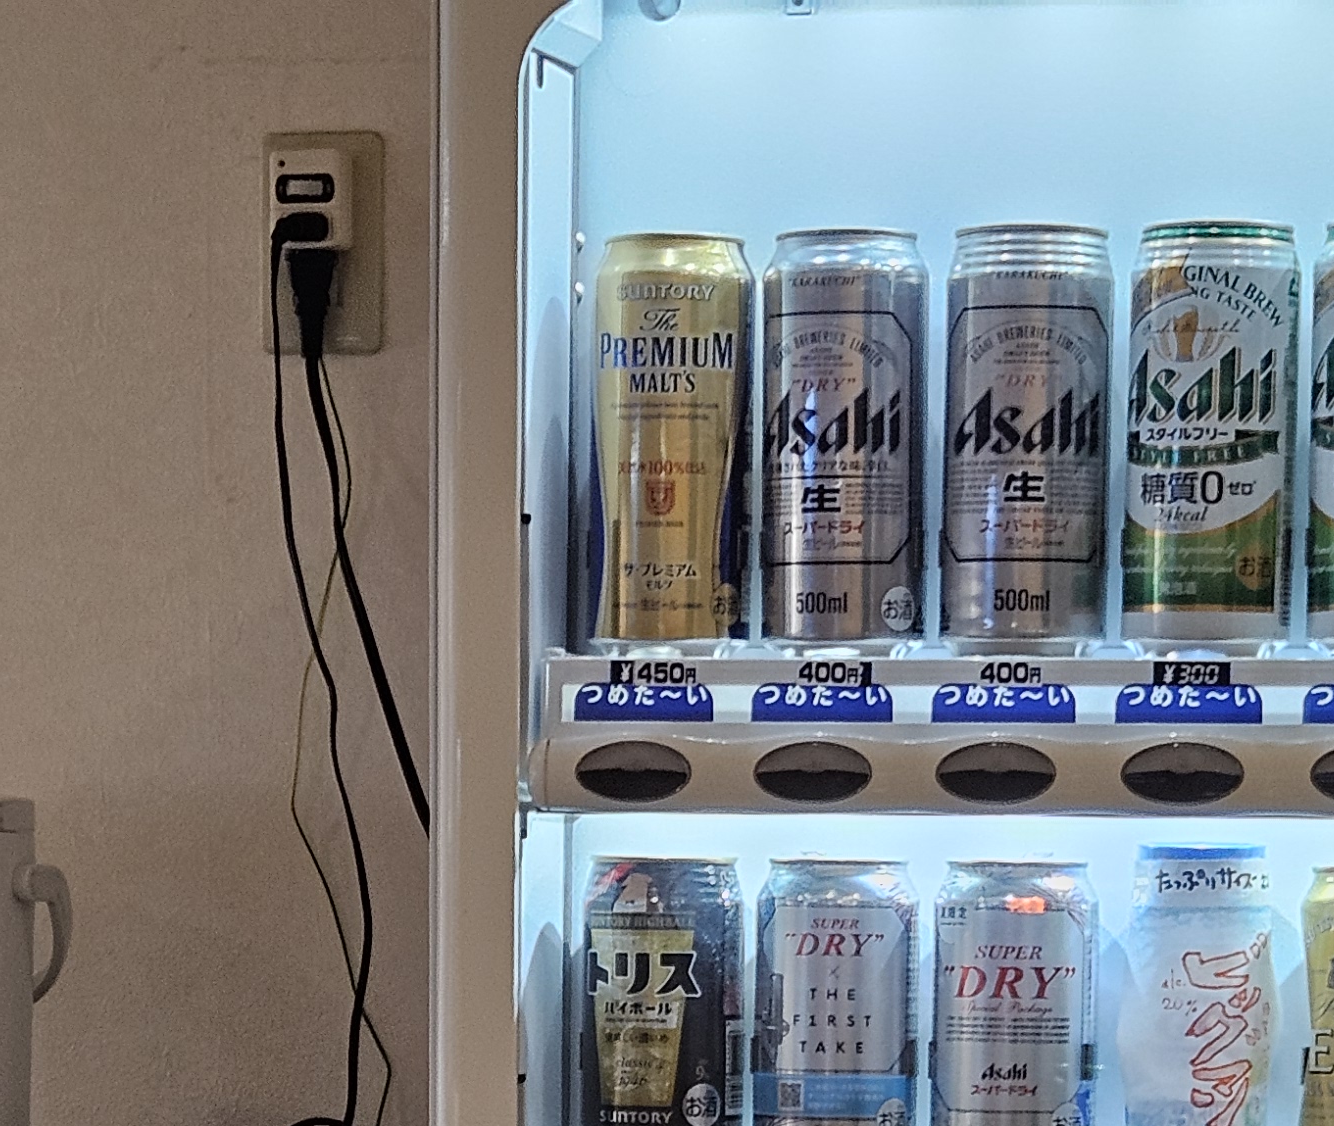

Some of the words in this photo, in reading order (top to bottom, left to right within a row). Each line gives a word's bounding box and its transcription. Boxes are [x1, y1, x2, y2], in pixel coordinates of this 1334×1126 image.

[617, 284, 714, 300] SUNTORY
[1217, 290, 1257, 320] TASTE
[1243, 282, 1284, 328] BREW
[639, 308, 680, 331] The
[600, 332, 734, 369] PREMIUM
[629, 370, 695, 393] MALT'S
[1128, 346, 1277, 425] Asahi
[766, 388, 900, 457] Asahi
[954, 387, 1100, 457] Asahi
[1146, 428, 1228, 441] スタイルフリー
[1003, 471, 1045, 502] 生
[801, 485, 841, 512] 生
[796, 592, 847, 613] 500ml
[994, 589, 1050, 612] 500ml
[799, 662, 858, 684] 400円
[980, 662, 1041, 684] 400円
[1163, 665, 1220, 685] ¥300
[811, 918, 859, 930] SUPER
[975, 945, 1042, 960] SUPER
[587, 950, 702, 997] トリス
[809, 988, 856, 1001] THE
[793, 1014, 872, 1027] FIRST
[799, 1041, 865, 1054] TAKE
[981, 1063, 1027, 1080] Asahi
[600, 1111, 672, 1124] SUNTORY
